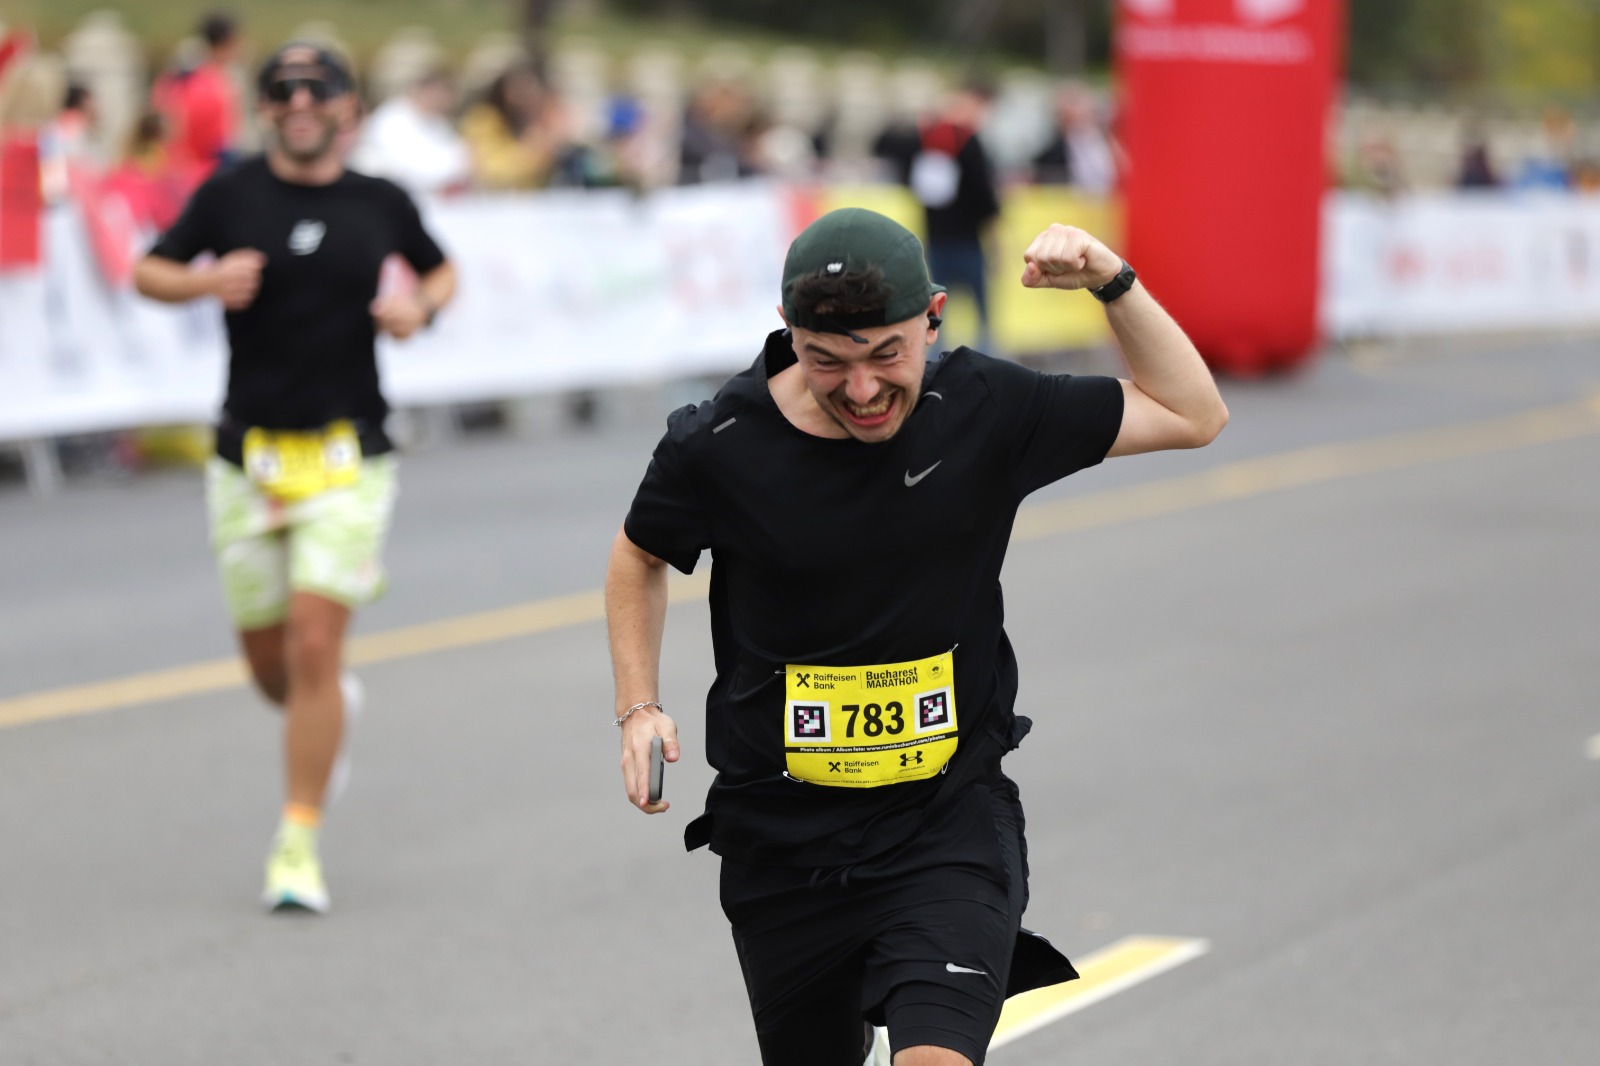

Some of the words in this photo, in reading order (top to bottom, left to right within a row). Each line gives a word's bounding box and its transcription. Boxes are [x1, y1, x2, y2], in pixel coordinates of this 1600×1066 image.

[813, 673, 857, 682] Raiffeisen
[866, 666, 918, 681] Bucharest
[813, 682, 835, 690] Bank
[866, 675, 919, 689] MARATHON
[841, 701, 905, 738] 783
